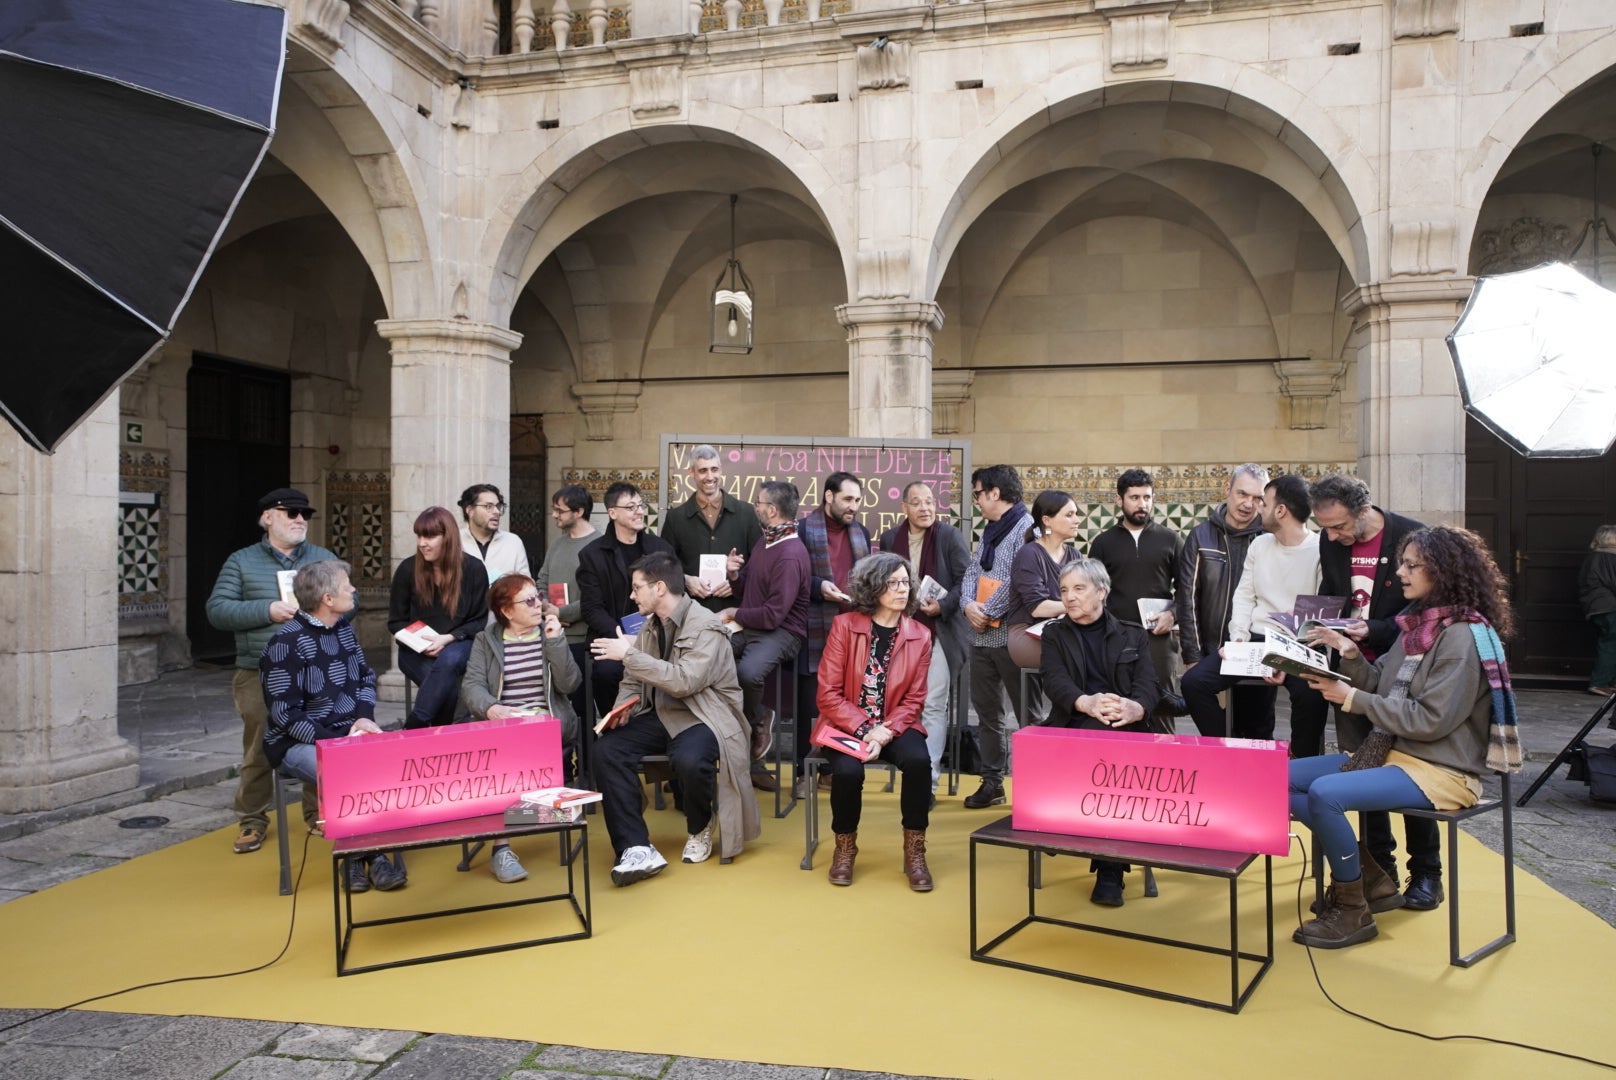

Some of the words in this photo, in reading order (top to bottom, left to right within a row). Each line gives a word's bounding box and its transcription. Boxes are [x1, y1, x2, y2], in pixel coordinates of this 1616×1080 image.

[761, 446, 808, 472] 75a
[815, 447, 868, 474] NIT
[874, 448, 913, 475] DE
[918, 449, 952, 476] LE
[399, 748, 497, 782] INSTITUT
[1091, 758, 1199, 795] ÒMNIUM
[337, 781, 446, 819] D'ESTUDIS
[447, 767, 553, 802] CATALANS
[1080, 791, 1210, 828] CULTURAL
